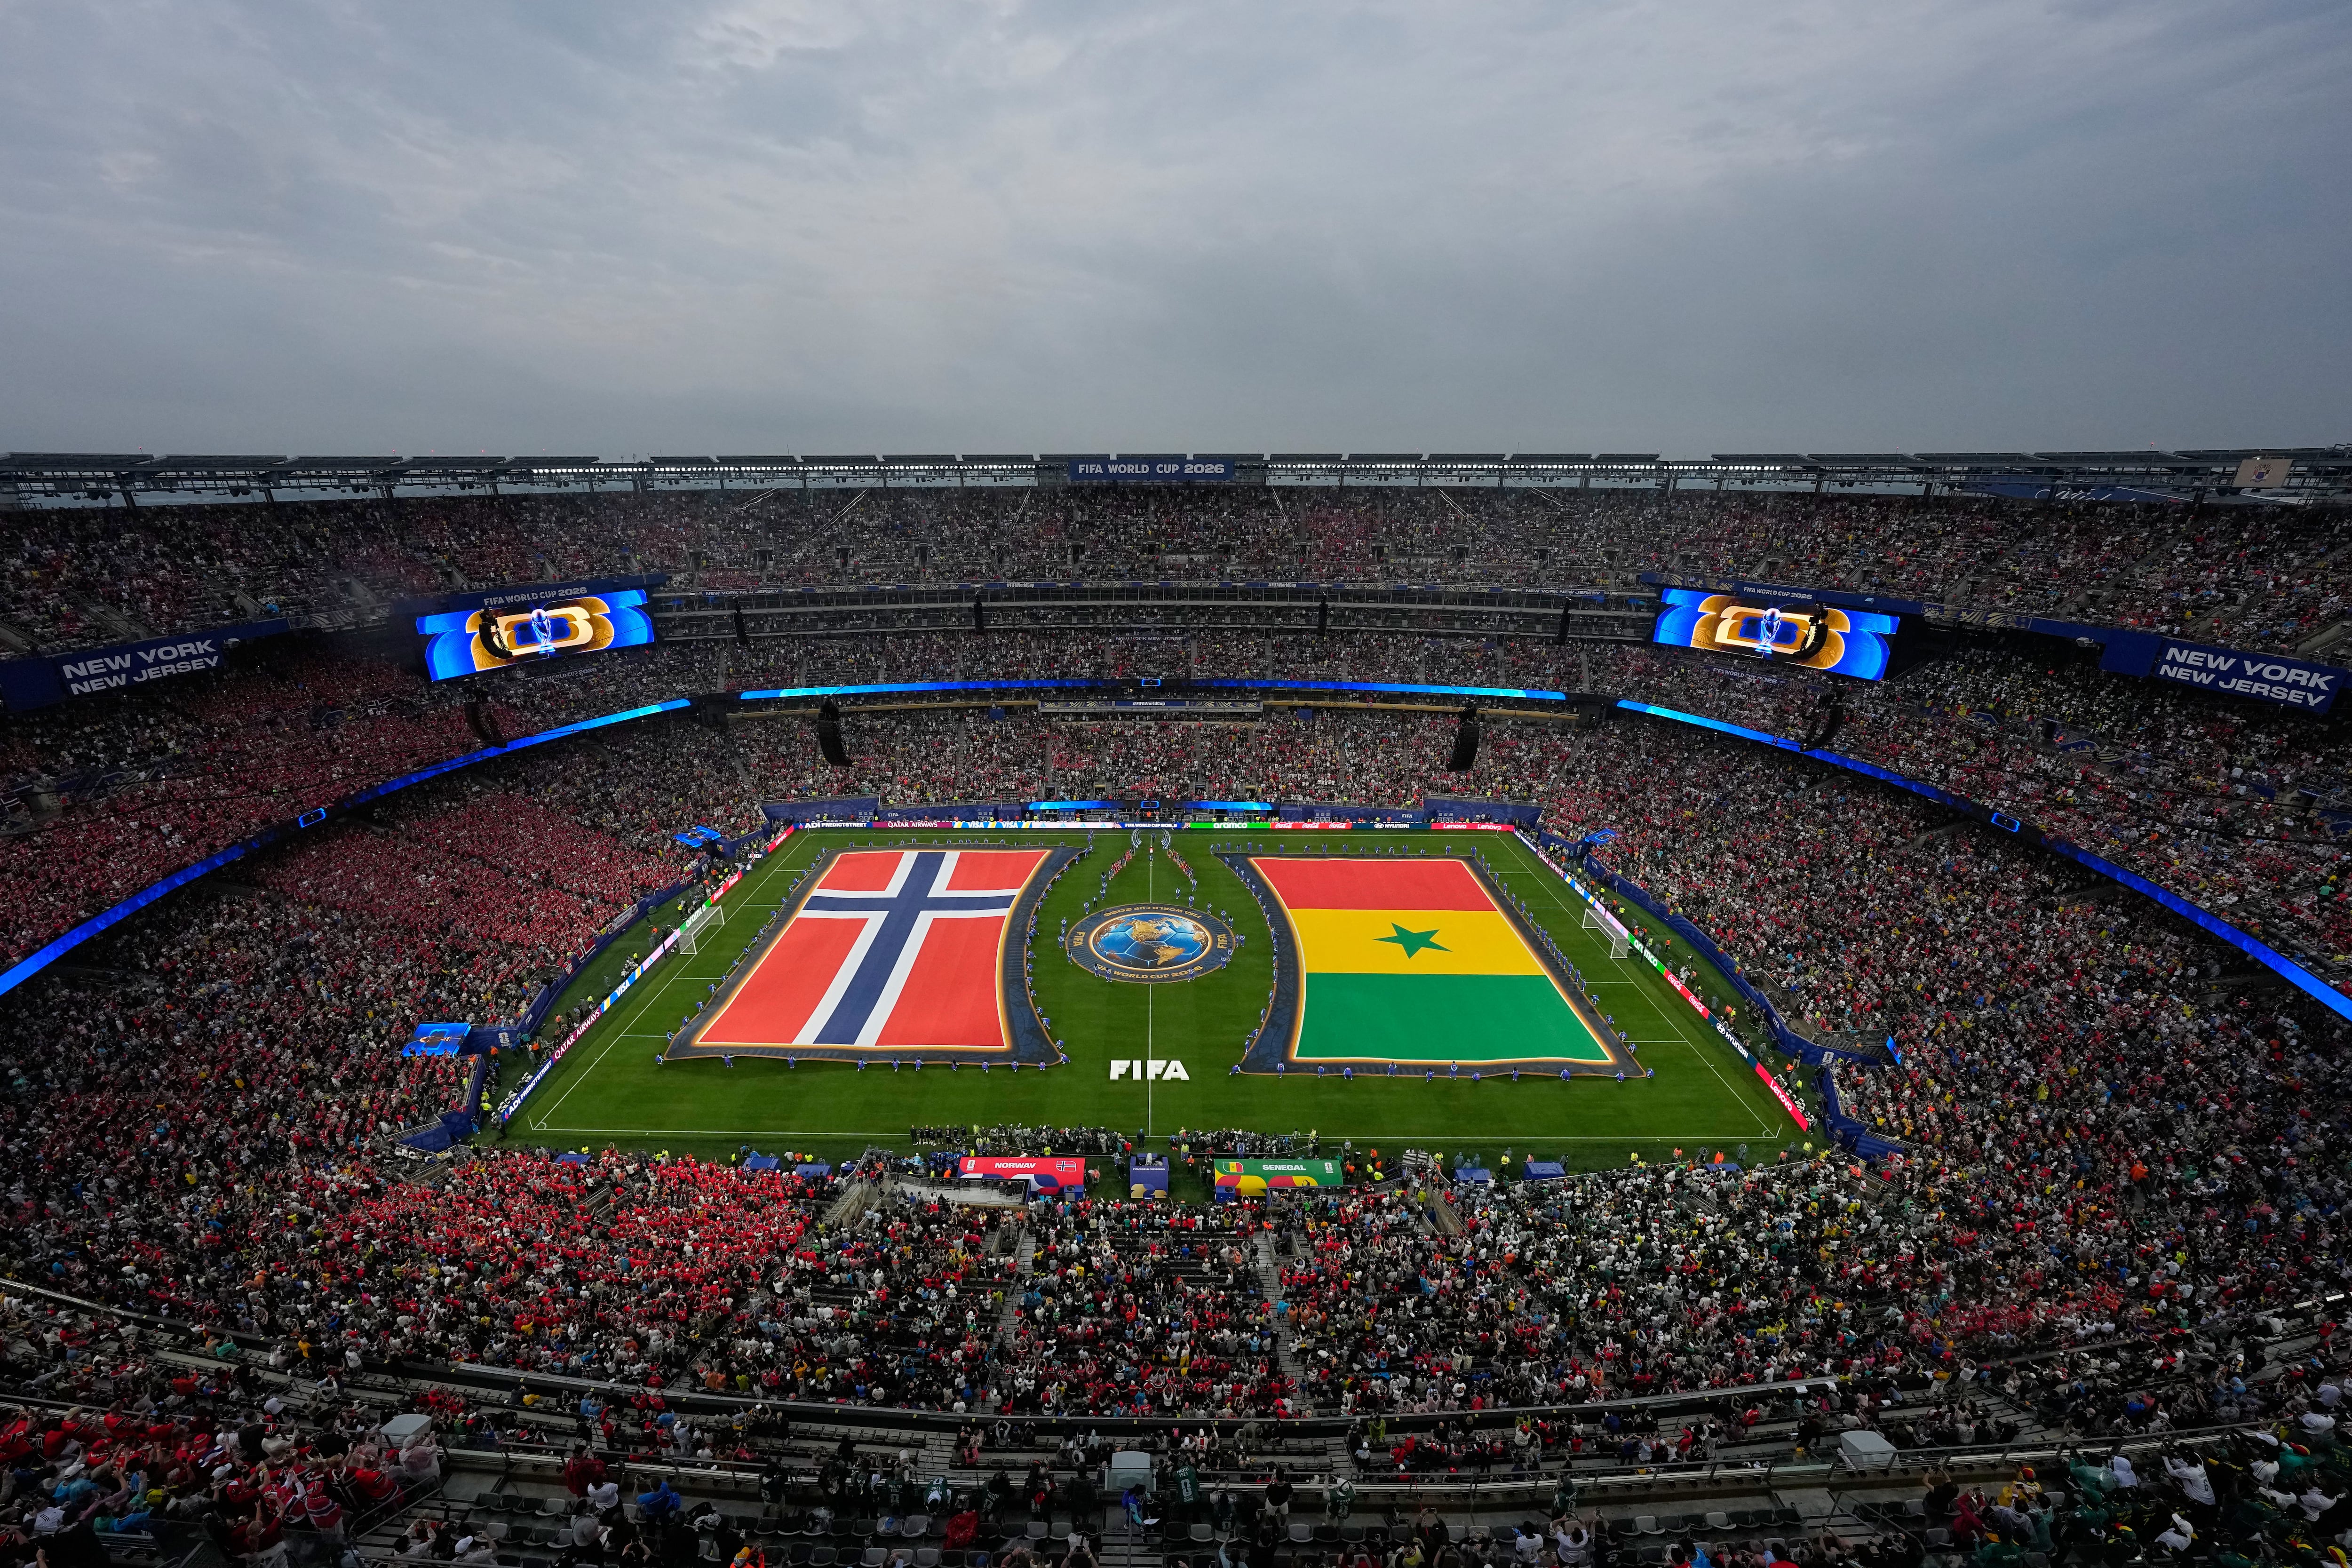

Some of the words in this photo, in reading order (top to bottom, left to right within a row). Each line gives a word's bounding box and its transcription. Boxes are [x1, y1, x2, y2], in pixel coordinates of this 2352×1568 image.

[1079, 464, 1103, 473] FIFA
[1108, 464, 1149, 473] WORLD
[1156, 464, 1179, 473] CUP
[1184, 464, 1224, 474] 2026
[484, 597, 504, 606] FIFA
[505, 593, 538, 602] WORLD
[540, 591, 556, 600] CUP
[558, 587, 588, 597] 2026
[63, 654, 131, 679] NEW
[138, 640, 216, 664] YORK
[71, 674, 126, 694] NEW
[133, 656, 218, 682] JERSEY
[1725, 670, 1745, 678] WORLD
[2165, 647, 2236, 671] NEW
[2244, 661, 2335, 691] YORK
[2160, 664, 2217, 684] NEW
[2219, 677, 2326, 706] JERSEY
[775, 833, 787, 846] Lenovo
[1538, 851, 1549, 865] QATAR
[1549, 861, 1565, 877] AIRWAYS
[1574, 883, 1585, 897] VISA
[1104, 907, 1130, 917] 2026
[1184, 910, 1202, 919] FIFA
[1073, 931, 1086, 947] FIFA
[1217, 933, 1227, 949] FIFA
[1113, 971, 1148, 979] WORLD
[1668, 974, 1683, 991] Coca-Cola
[615, 980, 630, 997] VISA
[1688, 995, 1705, 1013] Coca-Cola
[554, 1036, 575, 1059] QATAR
[576, 1009, 600, 1038] AIRWAYS
[1725, 1032, 1748, 1059] HYUNDAI
[1110, 1060, 1190, 1080] FIFA
[509, 1098, 521, 1115] ADI
[520, 1061, 552, 1100] PREDICTSTREET
[1770, 1080, 1793, 1111] Lenovo
[2203, 1480, 2209, 1491] 6
[1565, 1492, 1578, 1501] PHOTO
[1607, 1554, 1619, 1563] 8
